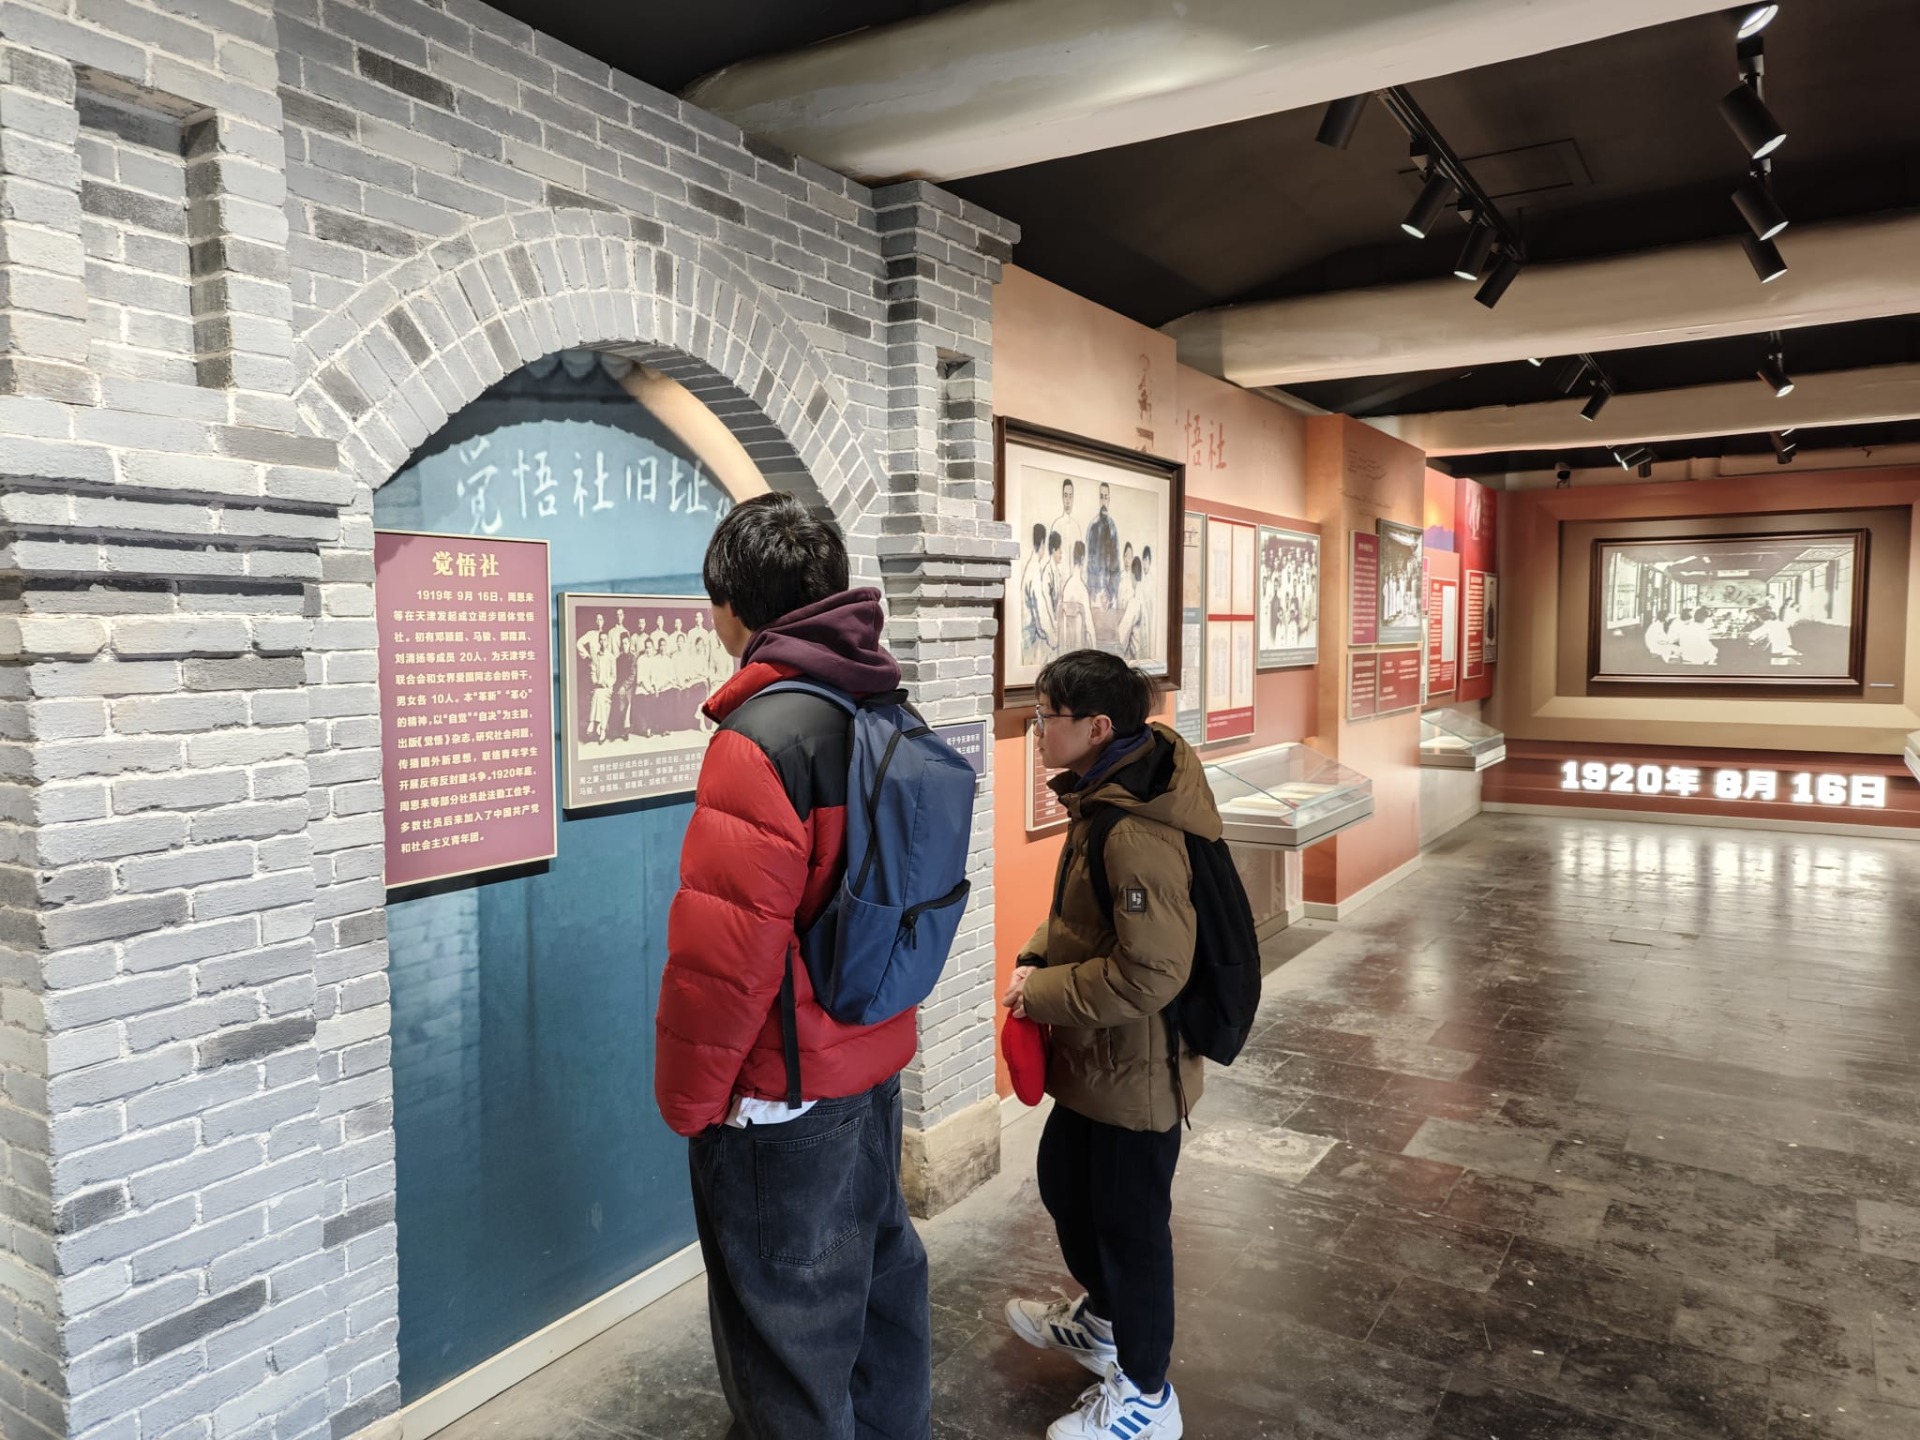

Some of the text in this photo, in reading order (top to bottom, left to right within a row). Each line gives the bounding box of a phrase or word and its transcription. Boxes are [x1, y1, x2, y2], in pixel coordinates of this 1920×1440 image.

[431, 551, 500, 578] 觉悟社
[417, 590, 453, 601] 1919年
[457, 590, 474, 602] 9月
[1561, 760, 1887, 808] 1920年 8月 16日
[400, 804, 540, 833] 多数社员后来加入了中国共产党
[401, 832, 485, 854] 和社会主义青年团。
